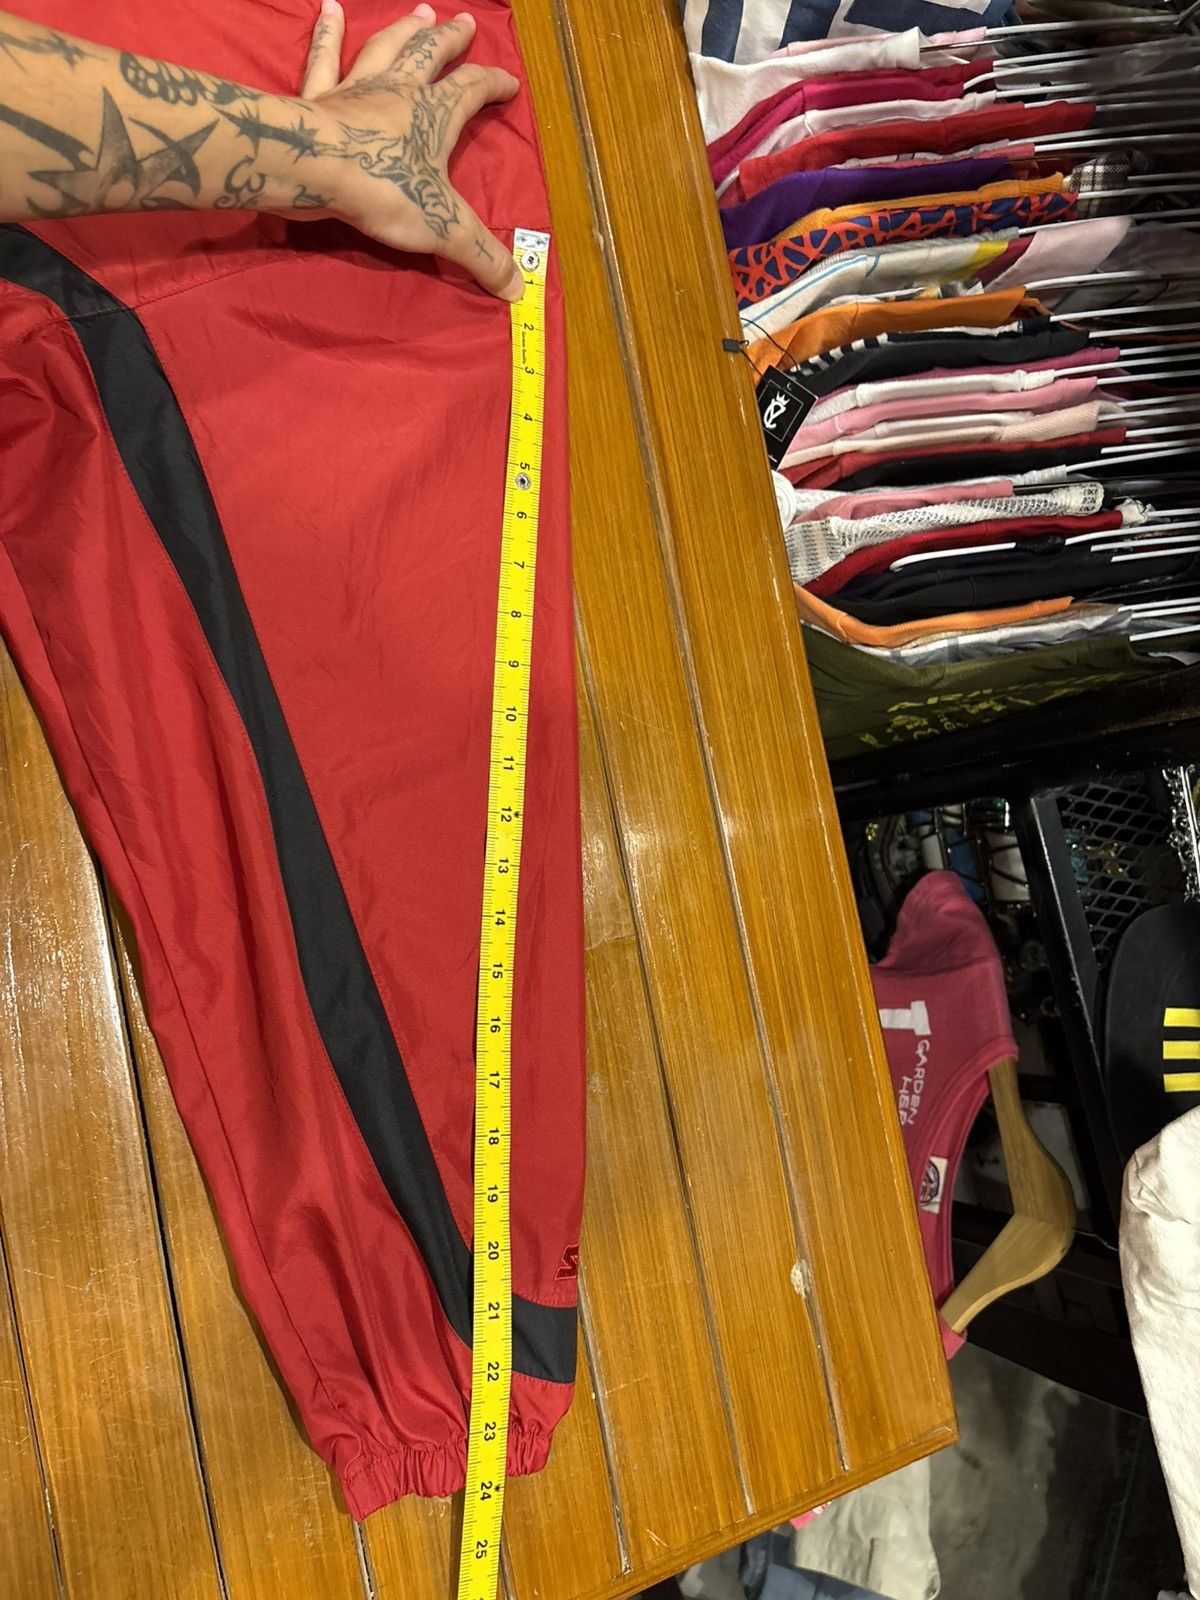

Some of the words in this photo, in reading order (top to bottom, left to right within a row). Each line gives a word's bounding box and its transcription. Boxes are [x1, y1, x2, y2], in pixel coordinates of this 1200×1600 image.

[523, 322, 535, 332] 2
[524, 366, 535, 375] 3
[523, 412, 534, 422] 4
[519, 461, 531, 471] 5
[516, 511, 528, 520] 6
[513, 560, 525, 570] 7
[510, 610, 522, 619] 8
[508, 659, 520, 668] 9
[505, 705, 517, 722] 10
[502, 755, 515, 772] 11
[500, 806, 513, 823] 12
[497, 857, 510, 874] 13
[494, 909, 507, 926] 14
[492, 962, 504, 979] 15
[489, 1016, 501, 1034] 16
[488, 1071, 500, 1089] 17
[905, 1038, 931, 1126] GARDEN
[488, 1127, 500, 1146] 18
[487, 1184, 499, 1203] 19
[487, 1240, 500, 1261] 20
[487, 1301, 500, 1321] 21
[486, 1361, 500, 1382] 22
[483, 1421, 497, 1442] 23
[479, 1480, 493, 1502] 24
[475, 1539, 488, 1560] 25
